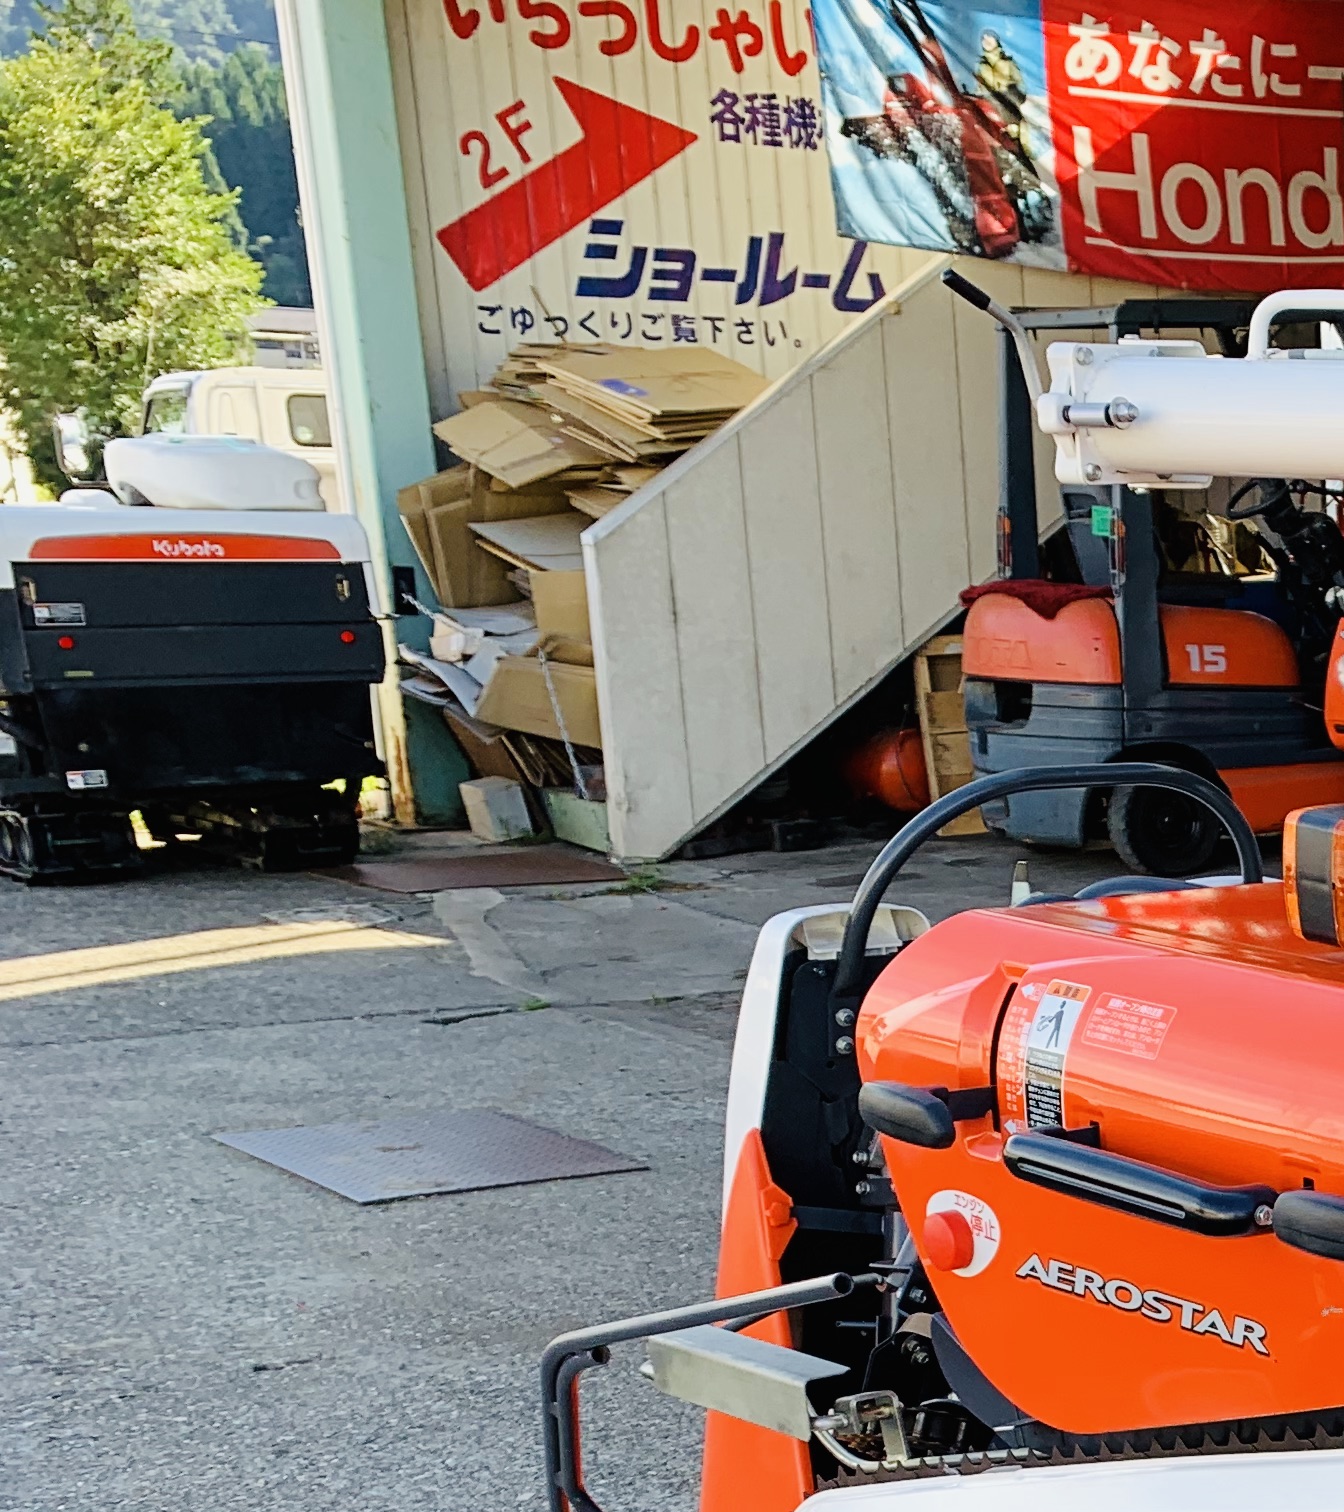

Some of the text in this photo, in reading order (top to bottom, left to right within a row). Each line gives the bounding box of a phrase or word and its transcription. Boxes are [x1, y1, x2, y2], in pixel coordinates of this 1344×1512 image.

[459, 98, 533, 190] 2F
[709, 88, 824, 151] 各種機
[575, 218, 887, 312] ショールーム
[477, 303, 804, 349] ごゆっくりご覧下さい。
[152, 539, 225, 557] Kubota
[1185, 643, 1228, 673] 15
[954, 1194, 984, 1213] エンジン
[1015, 1253, 1270, 1356] AEROSTAR
